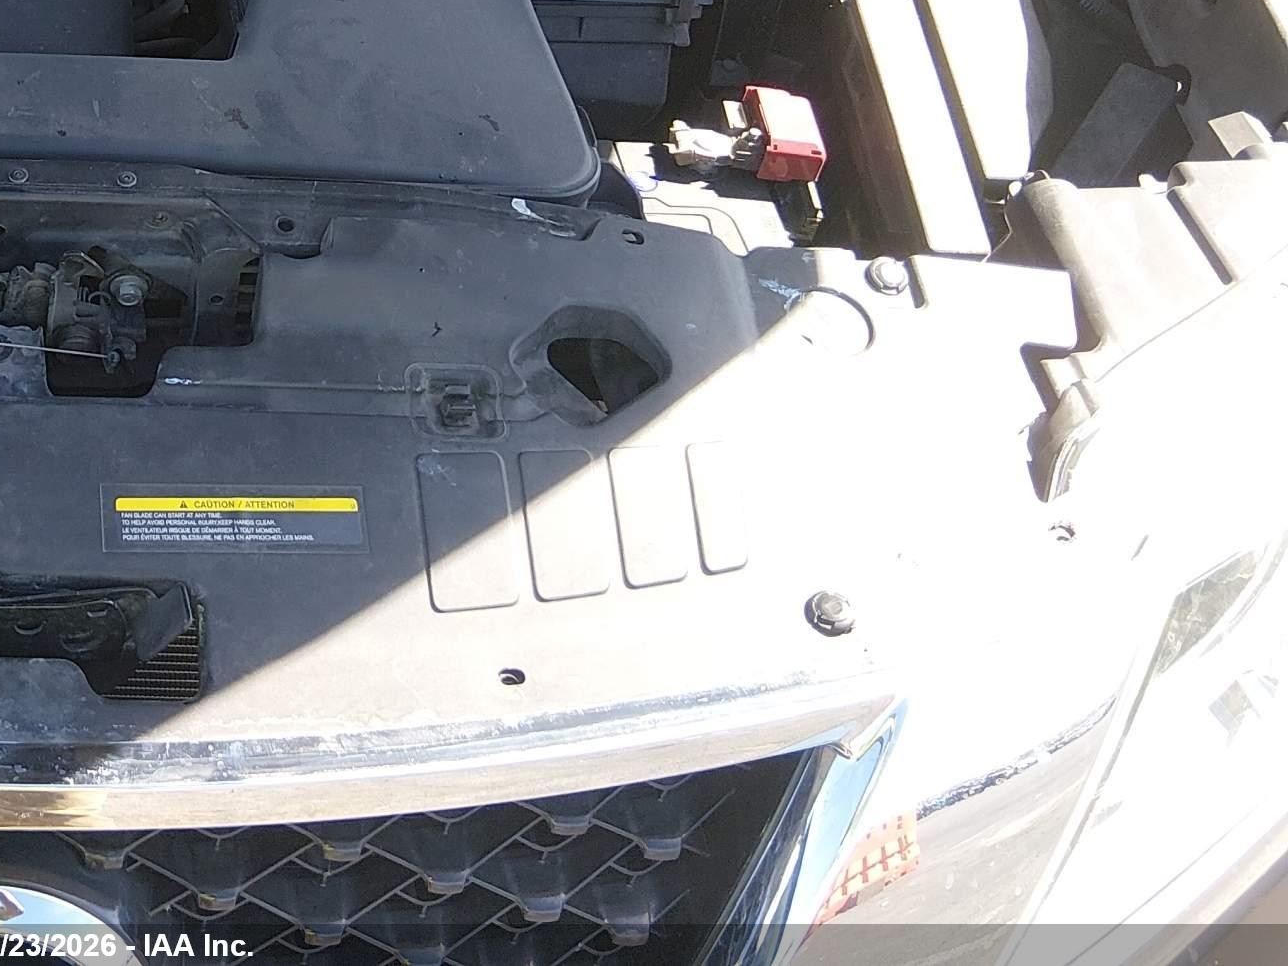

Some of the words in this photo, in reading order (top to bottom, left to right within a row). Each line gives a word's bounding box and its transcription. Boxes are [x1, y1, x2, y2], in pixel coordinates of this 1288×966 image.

[193, 501, 235, 509] CAUTION
[238, 501, 242, 509] /
[244, 501, 295, 509] ATTENTION
